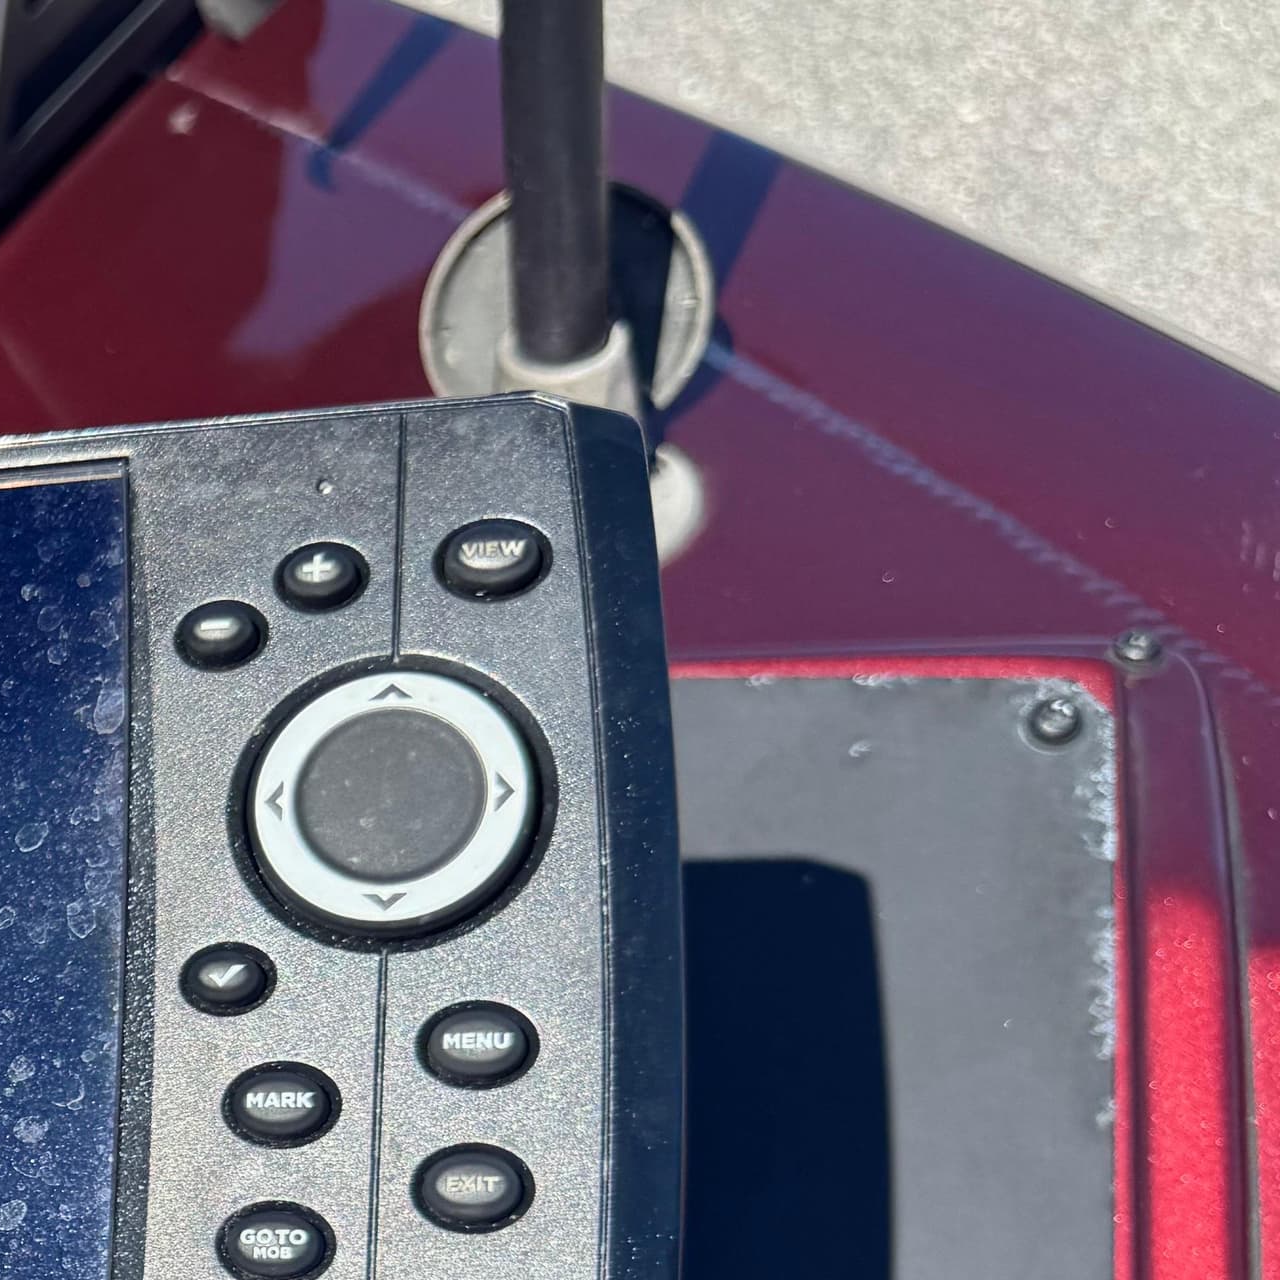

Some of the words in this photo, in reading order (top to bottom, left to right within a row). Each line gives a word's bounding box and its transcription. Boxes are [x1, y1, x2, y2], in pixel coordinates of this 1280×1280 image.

[461, 540, 526, 559] VIEW
[442, 1031, 513, 1051] MENU
[245, 1091, 316, 1110] MARK
[445, 1176, 501, 1193] EXIT
[253, 1246, 293, 1259] MOB
